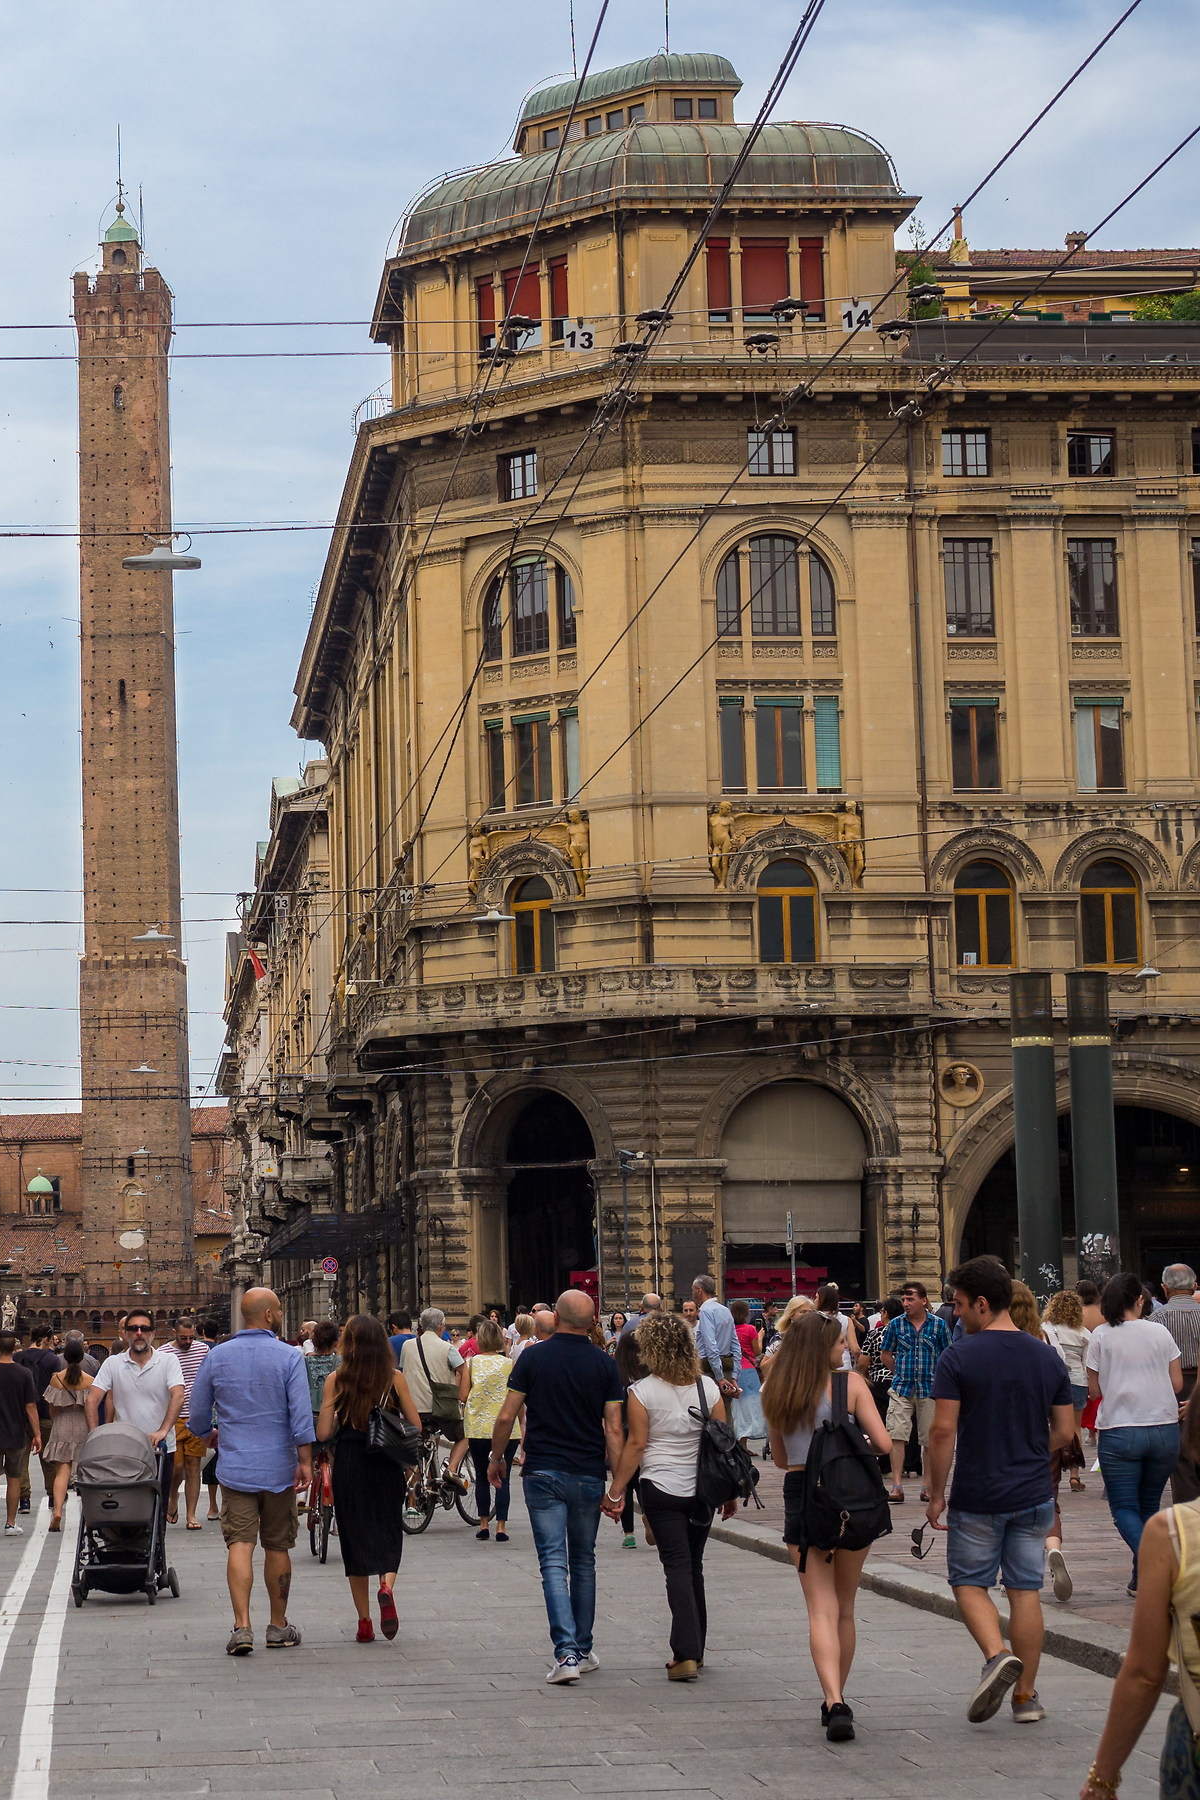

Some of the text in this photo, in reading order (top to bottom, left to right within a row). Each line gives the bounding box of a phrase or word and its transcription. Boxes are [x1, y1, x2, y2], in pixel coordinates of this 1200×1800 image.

[842, 309, 871, 328] 14
[565, 330, 594, 349] 13
[275, 899, 288, 908] 13
[400, 893, 413, 902] 14
